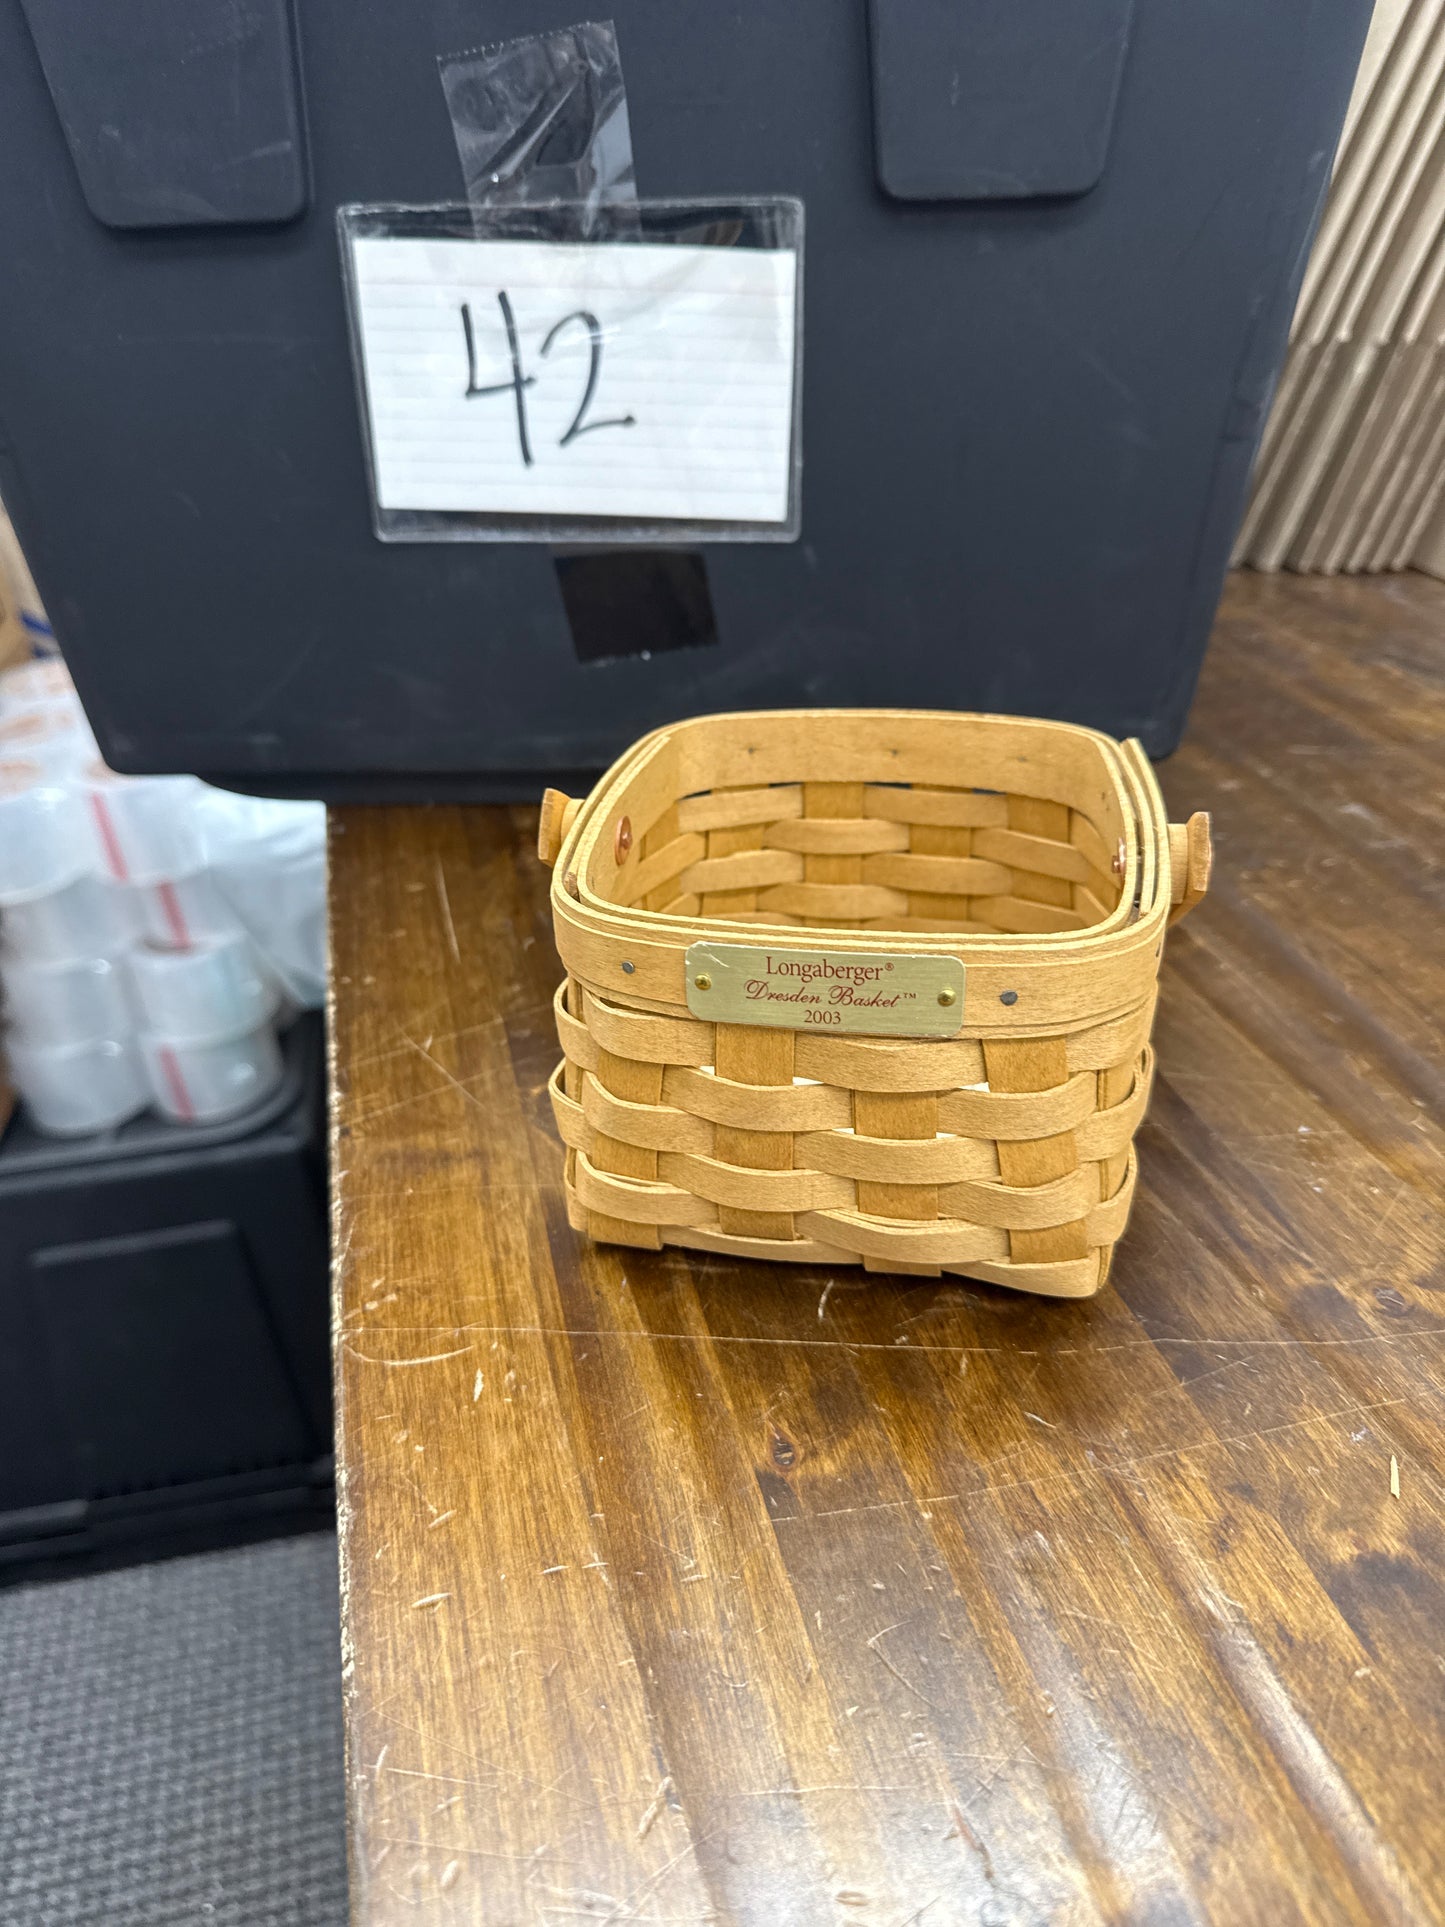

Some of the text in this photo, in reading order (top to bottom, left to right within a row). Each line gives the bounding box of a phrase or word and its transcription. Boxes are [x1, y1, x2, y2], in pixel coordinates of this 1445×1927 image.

[460, 290, 636, 467] 42
[743, 979, 823, 1004] Dresden
[803, 1009, 842, 1025] 2003
